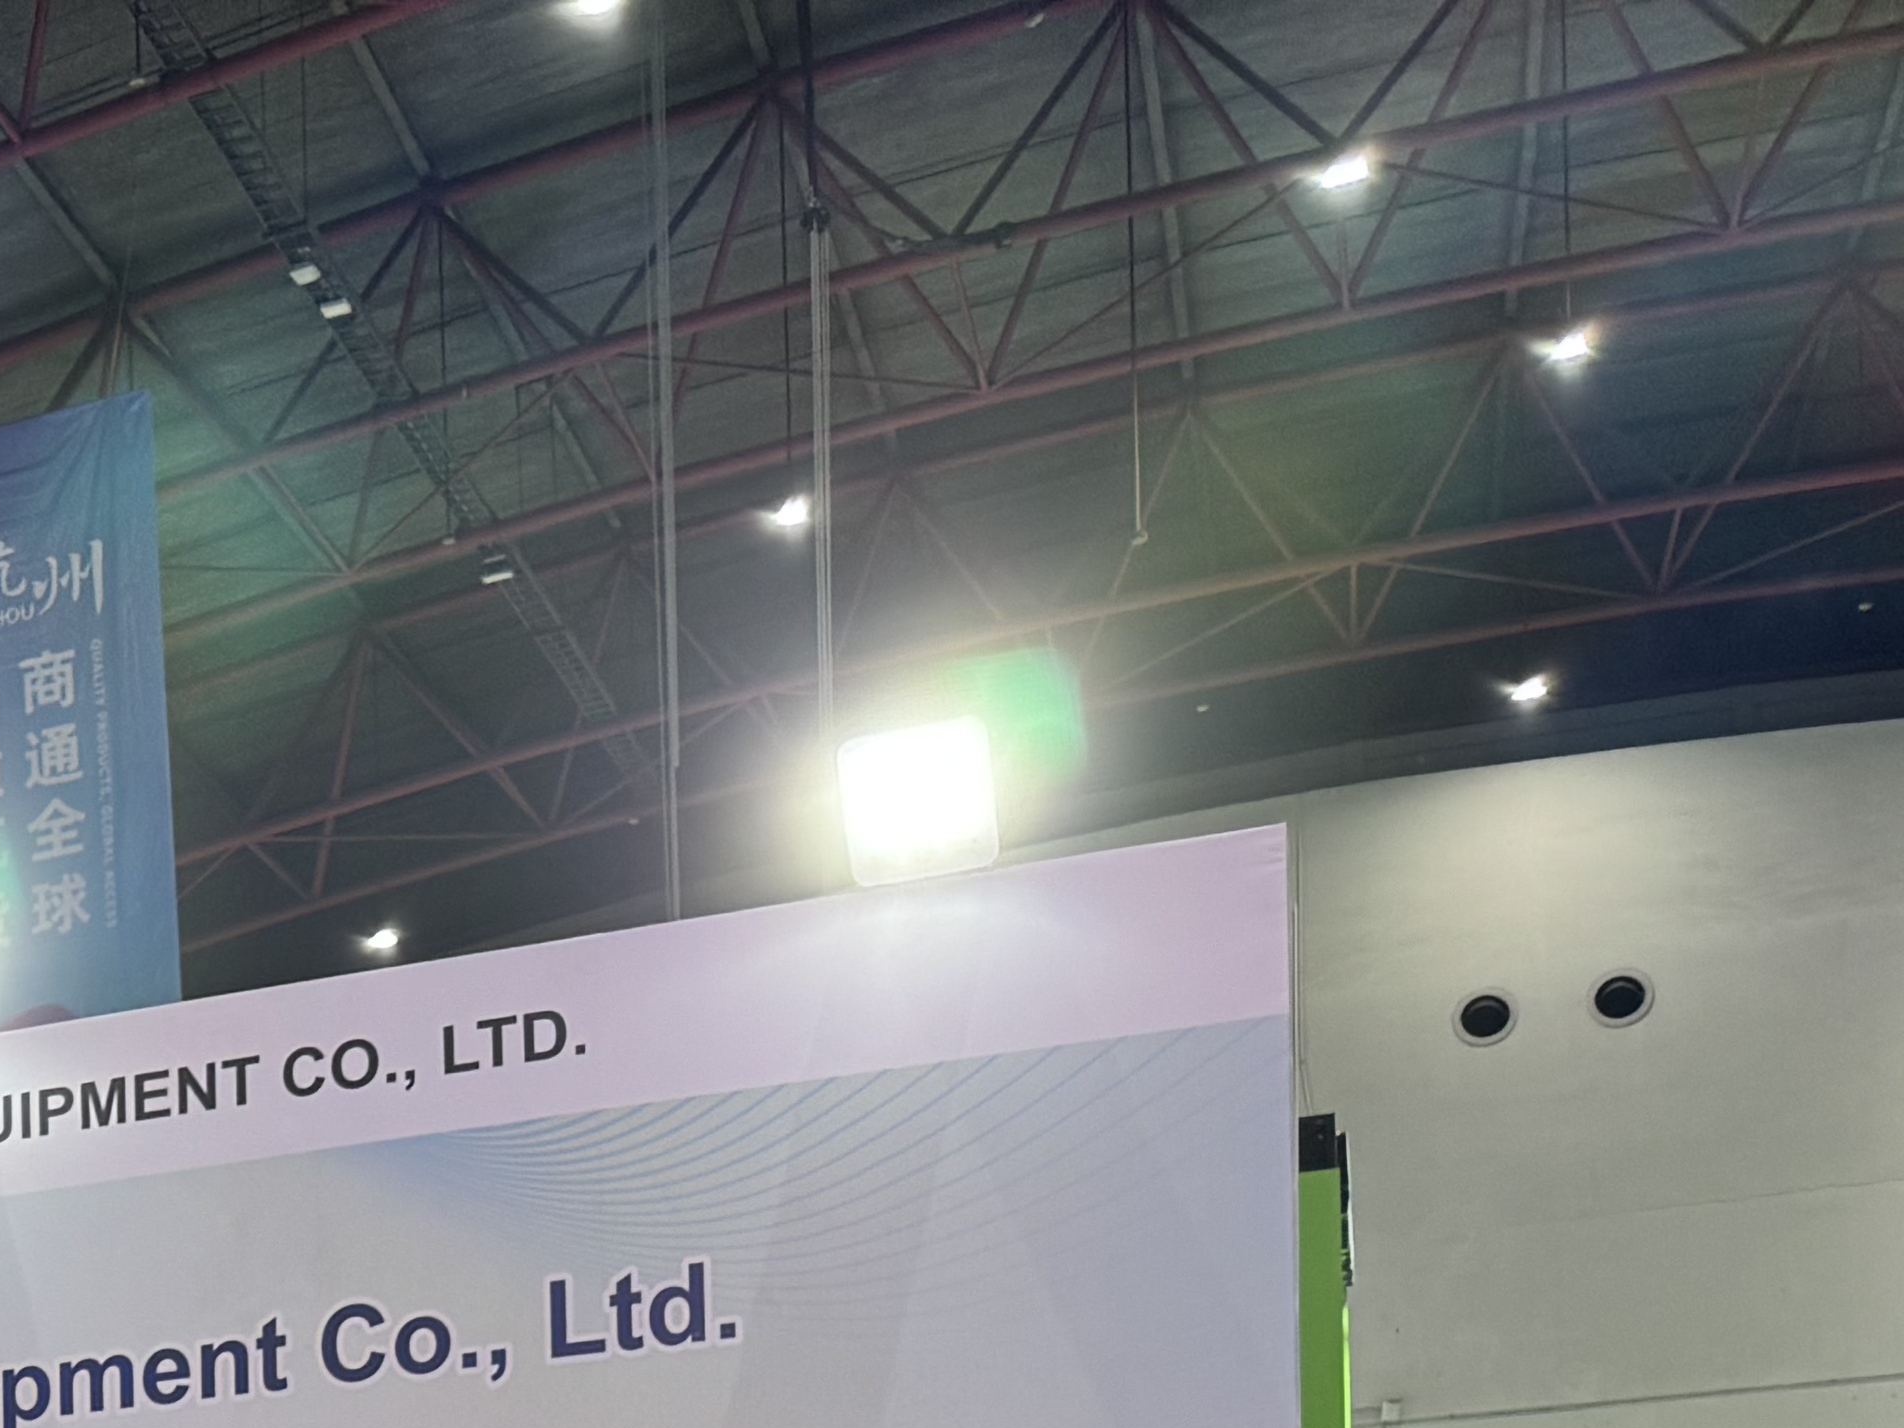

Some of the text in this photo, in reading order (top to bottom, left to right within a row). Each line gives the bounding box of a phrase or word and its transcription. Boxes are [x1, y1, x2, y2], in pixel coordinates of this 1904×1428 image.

[18, 648, 90, 935] 商通全球
[283, 1038, 418, 1100] CO.,
[442, 1010, 588, 1076] LTD.
[320, 1303, 509, 1384] Co.,
[548, 1262, 737, 1360] Ltd.
